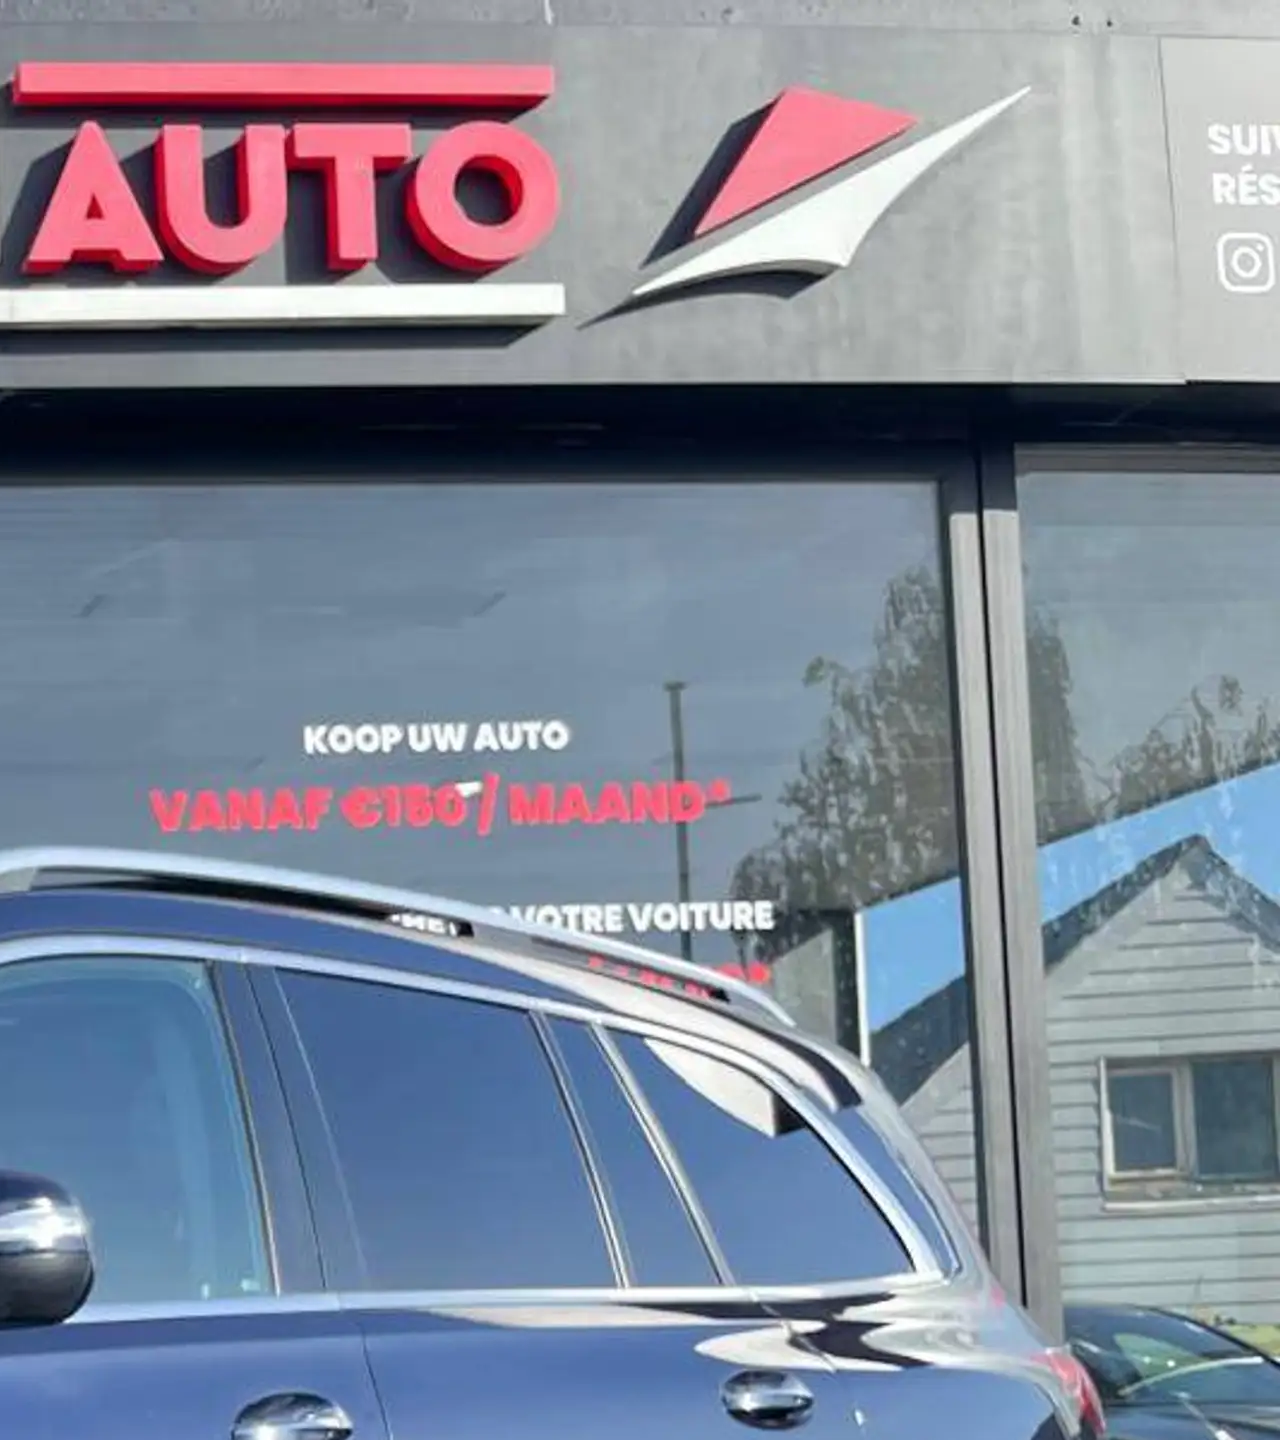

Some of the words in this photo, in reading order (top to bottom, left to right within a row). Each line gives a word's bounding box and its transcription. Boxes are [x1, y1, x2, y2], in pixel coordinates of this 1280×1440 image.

[22, 120, 560, 274] AUTO
[303, 721, 405, 755] KOOP
[407, 721, 469, 753] UW
[473, 719, 571, 751] AUTO
[150, 787, 333, 833] VANAF
[627, 900, 775, 932] VOITURE
